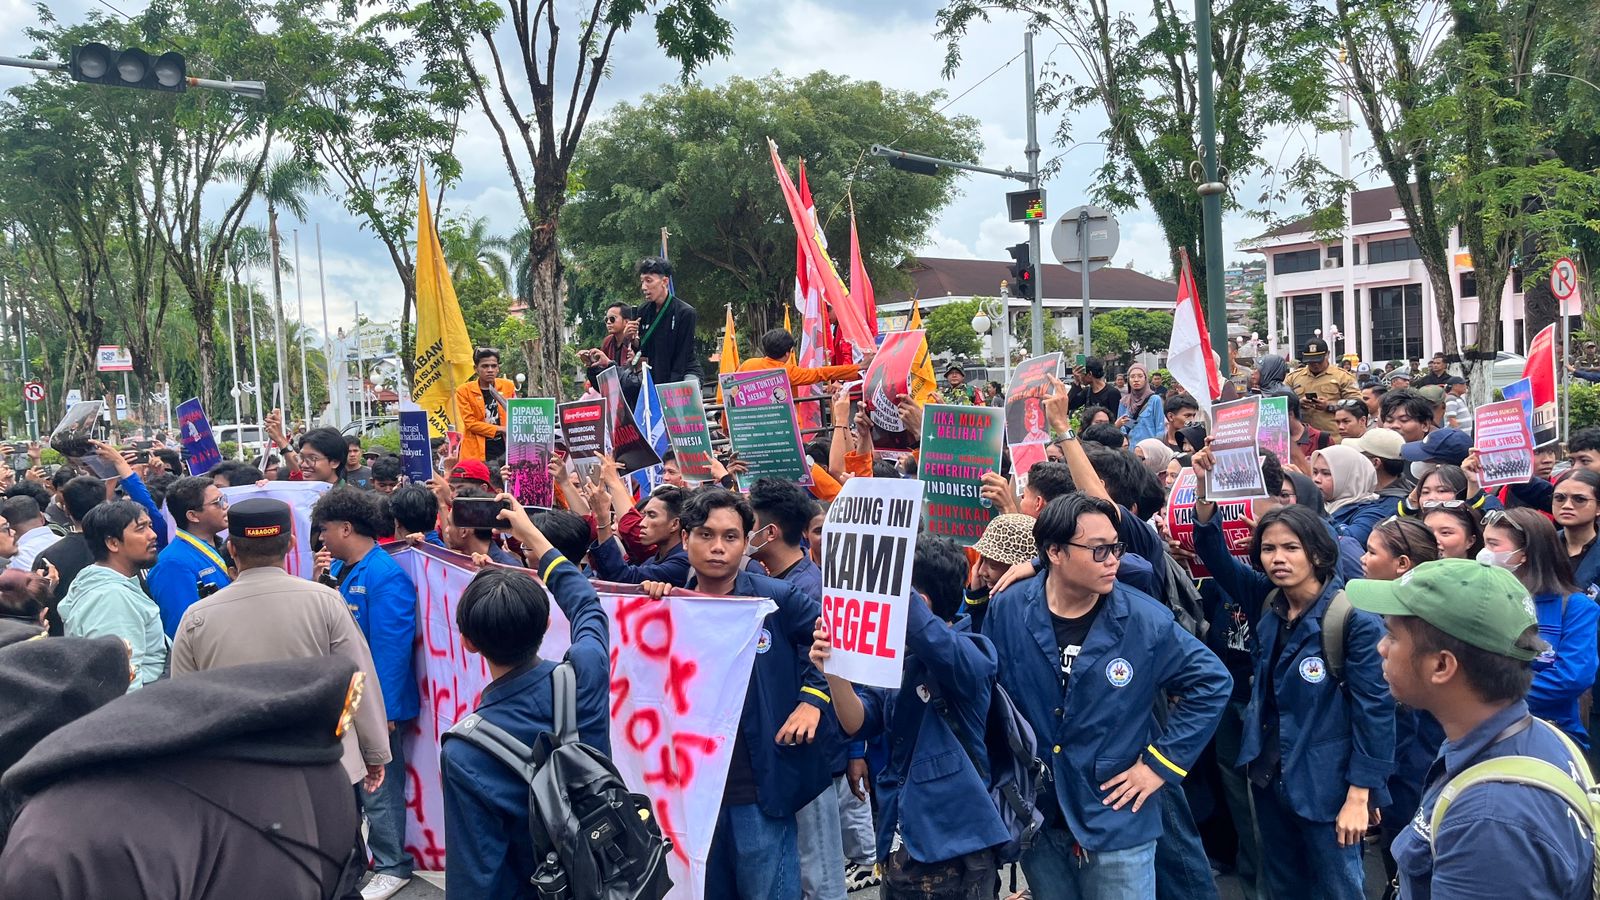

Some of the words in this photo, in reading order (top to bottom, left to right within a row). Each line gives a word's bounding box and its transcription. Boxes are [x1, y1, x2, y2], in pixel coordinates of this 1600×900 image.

[420, 360, 440, 383] ISLAM
[756, 376, 785, 390] TUNTUTAN
[738, 390, 746, 406] 9
[747, 391, 768, 402] DAERAH
[512, 406, 543, 415] DIPAKSA
[512, 416, 549, 424] BERTAHAN
[933, 411, 955, 425] JIKA
[512, 425, 521, 433] DI
[937, 426, 984, 441] MELIHAT
[512, 434, 535, 442] YANG
[1497, 435, 1523, 446] STRESS
[828, 497, 884, 526] GEDUNG
[887, 498, 914, 528] INI
[247, 526, 279, 537] KABAGOPS
[823, 532, 908, 596] KAMI
[822, 595, 896, 658] SEGEL
